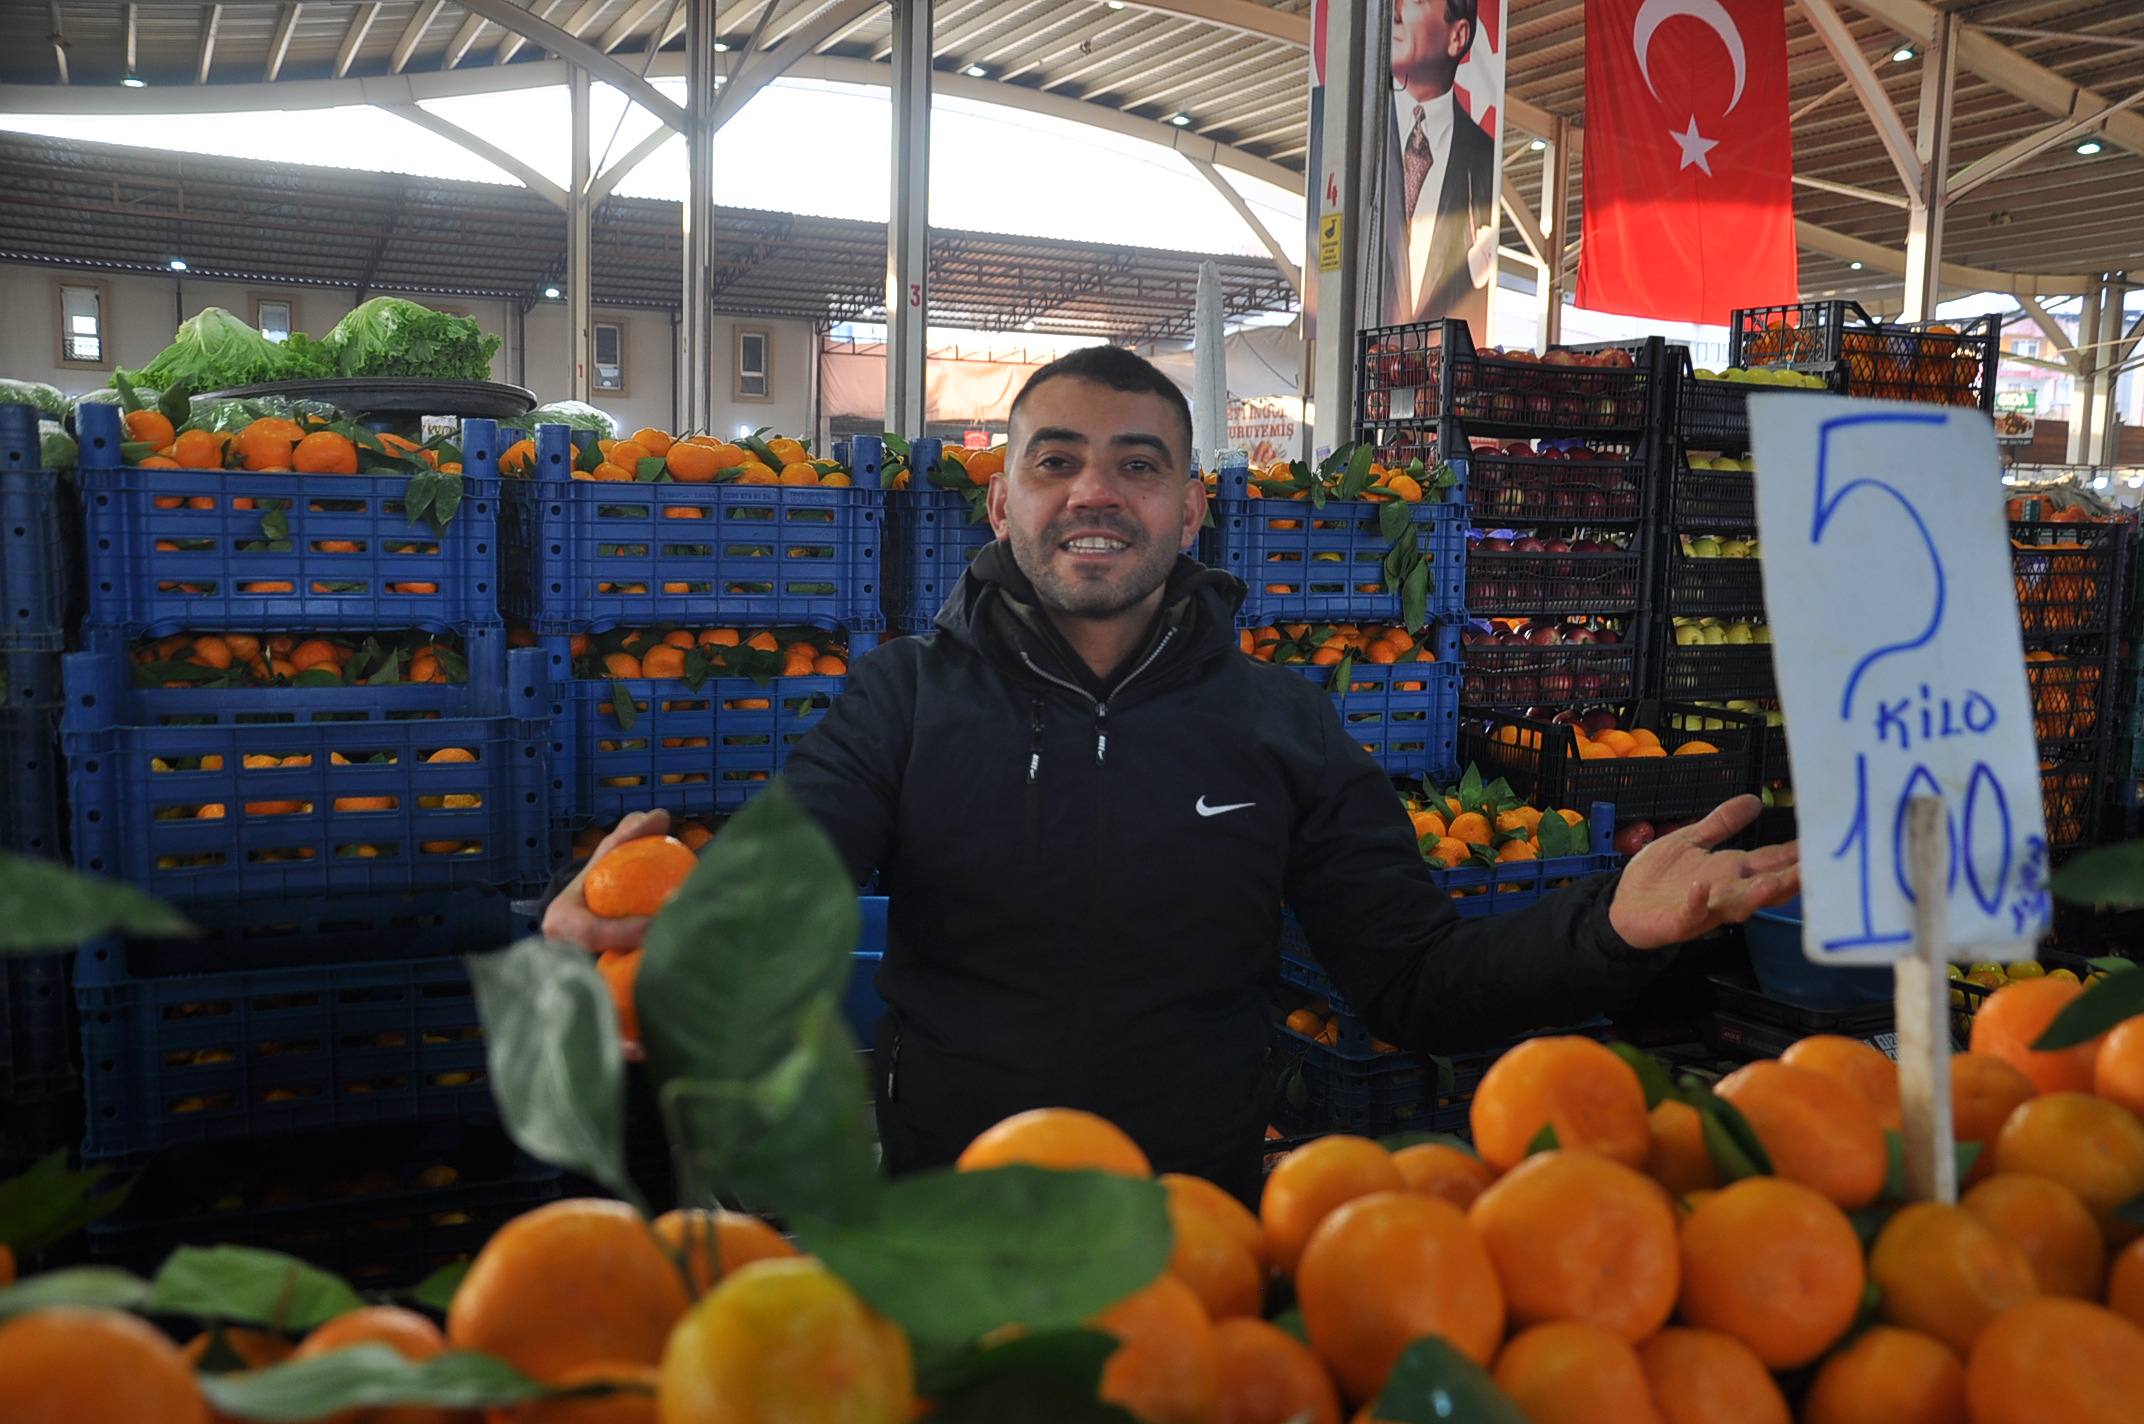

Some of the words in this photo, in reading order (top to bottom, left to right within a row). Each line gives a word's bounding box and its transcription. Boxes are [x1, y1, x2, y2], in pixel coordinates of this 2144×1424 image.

[1326, 172, 1338, 207] 4
[910, 284, 921, 307] 3
[1228, 422, 1295, 441] URUYEMİŞ
[1810, 412, 1948, 719] 5
[1821, 752, 2013, 951] 100
